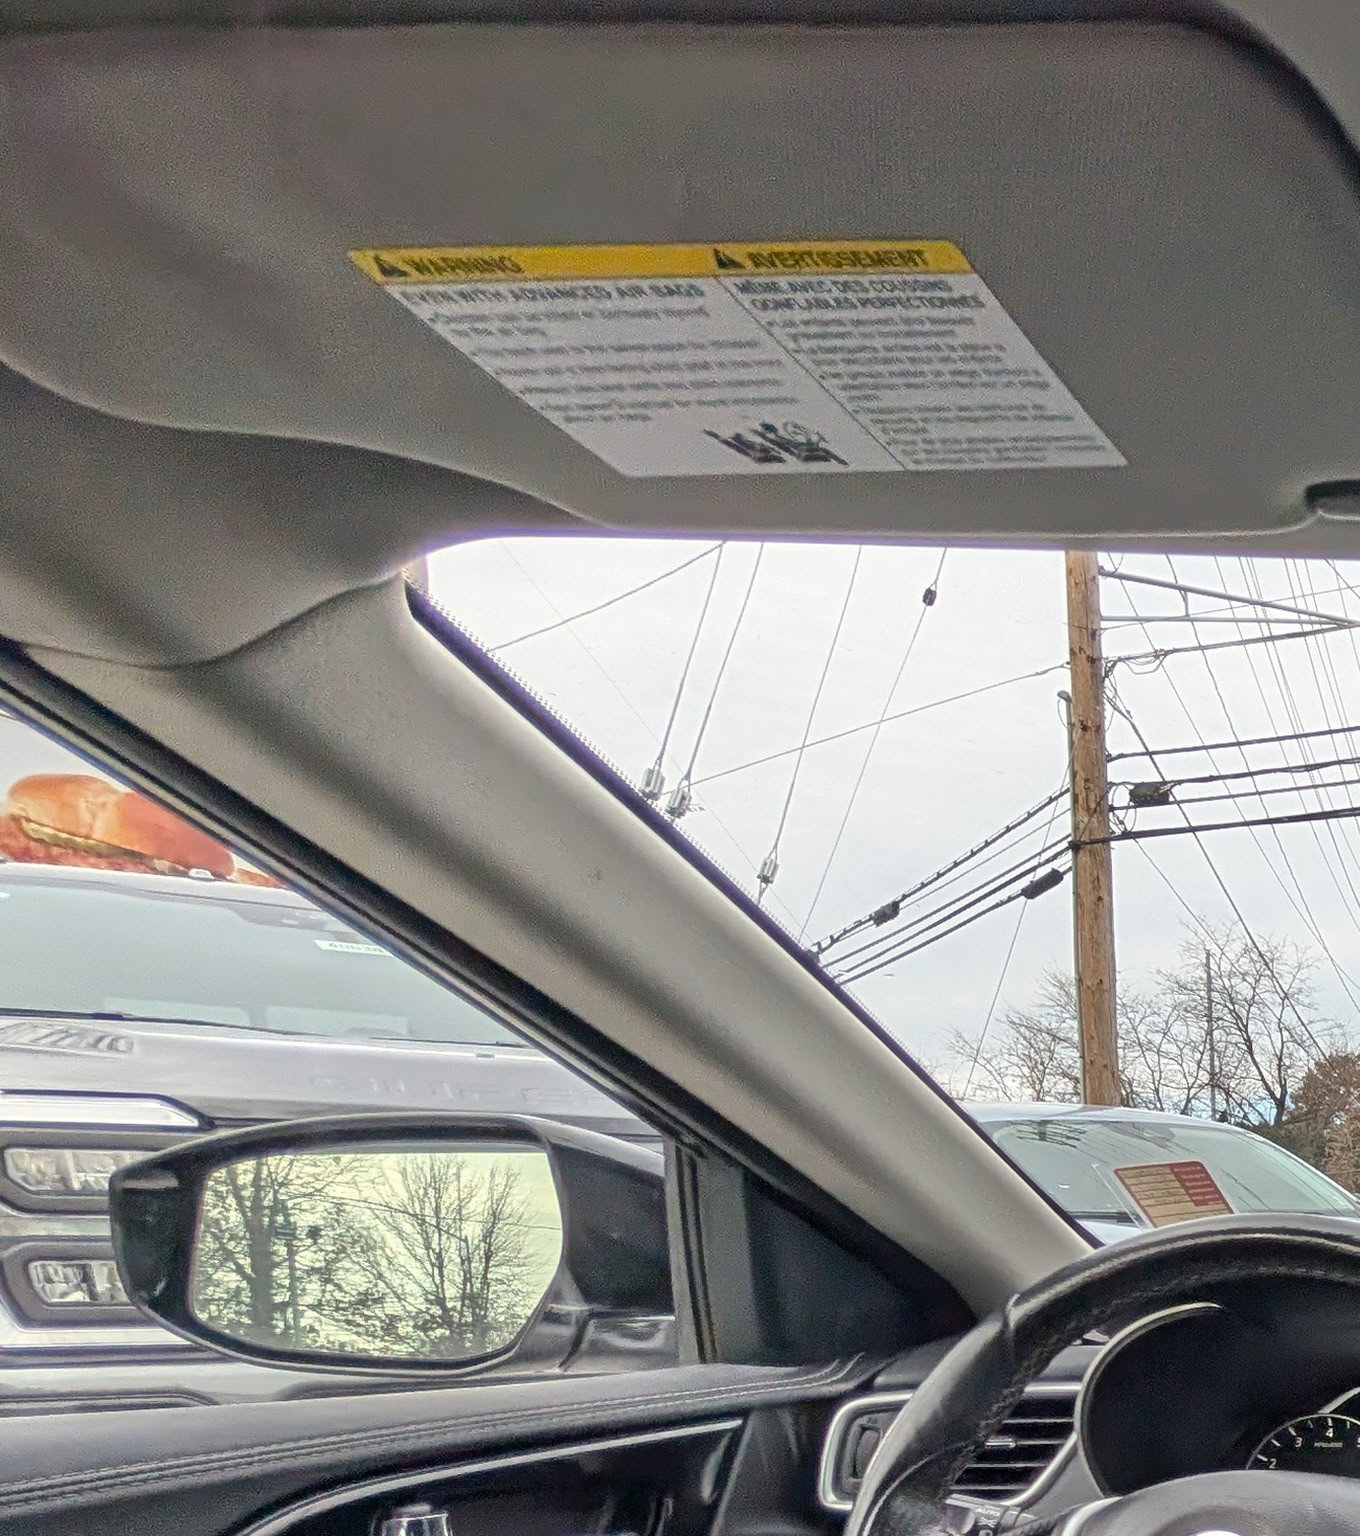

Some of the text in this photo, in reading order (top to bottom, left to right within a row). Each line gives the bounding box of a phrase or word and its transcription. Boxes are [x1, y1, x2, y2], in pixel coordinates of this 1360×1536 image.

[1325, 1427, 1334, 1438] 4
[1294, 1437, 1303, 1448] 3
[1268, 1459, 1277, 1469] 2
